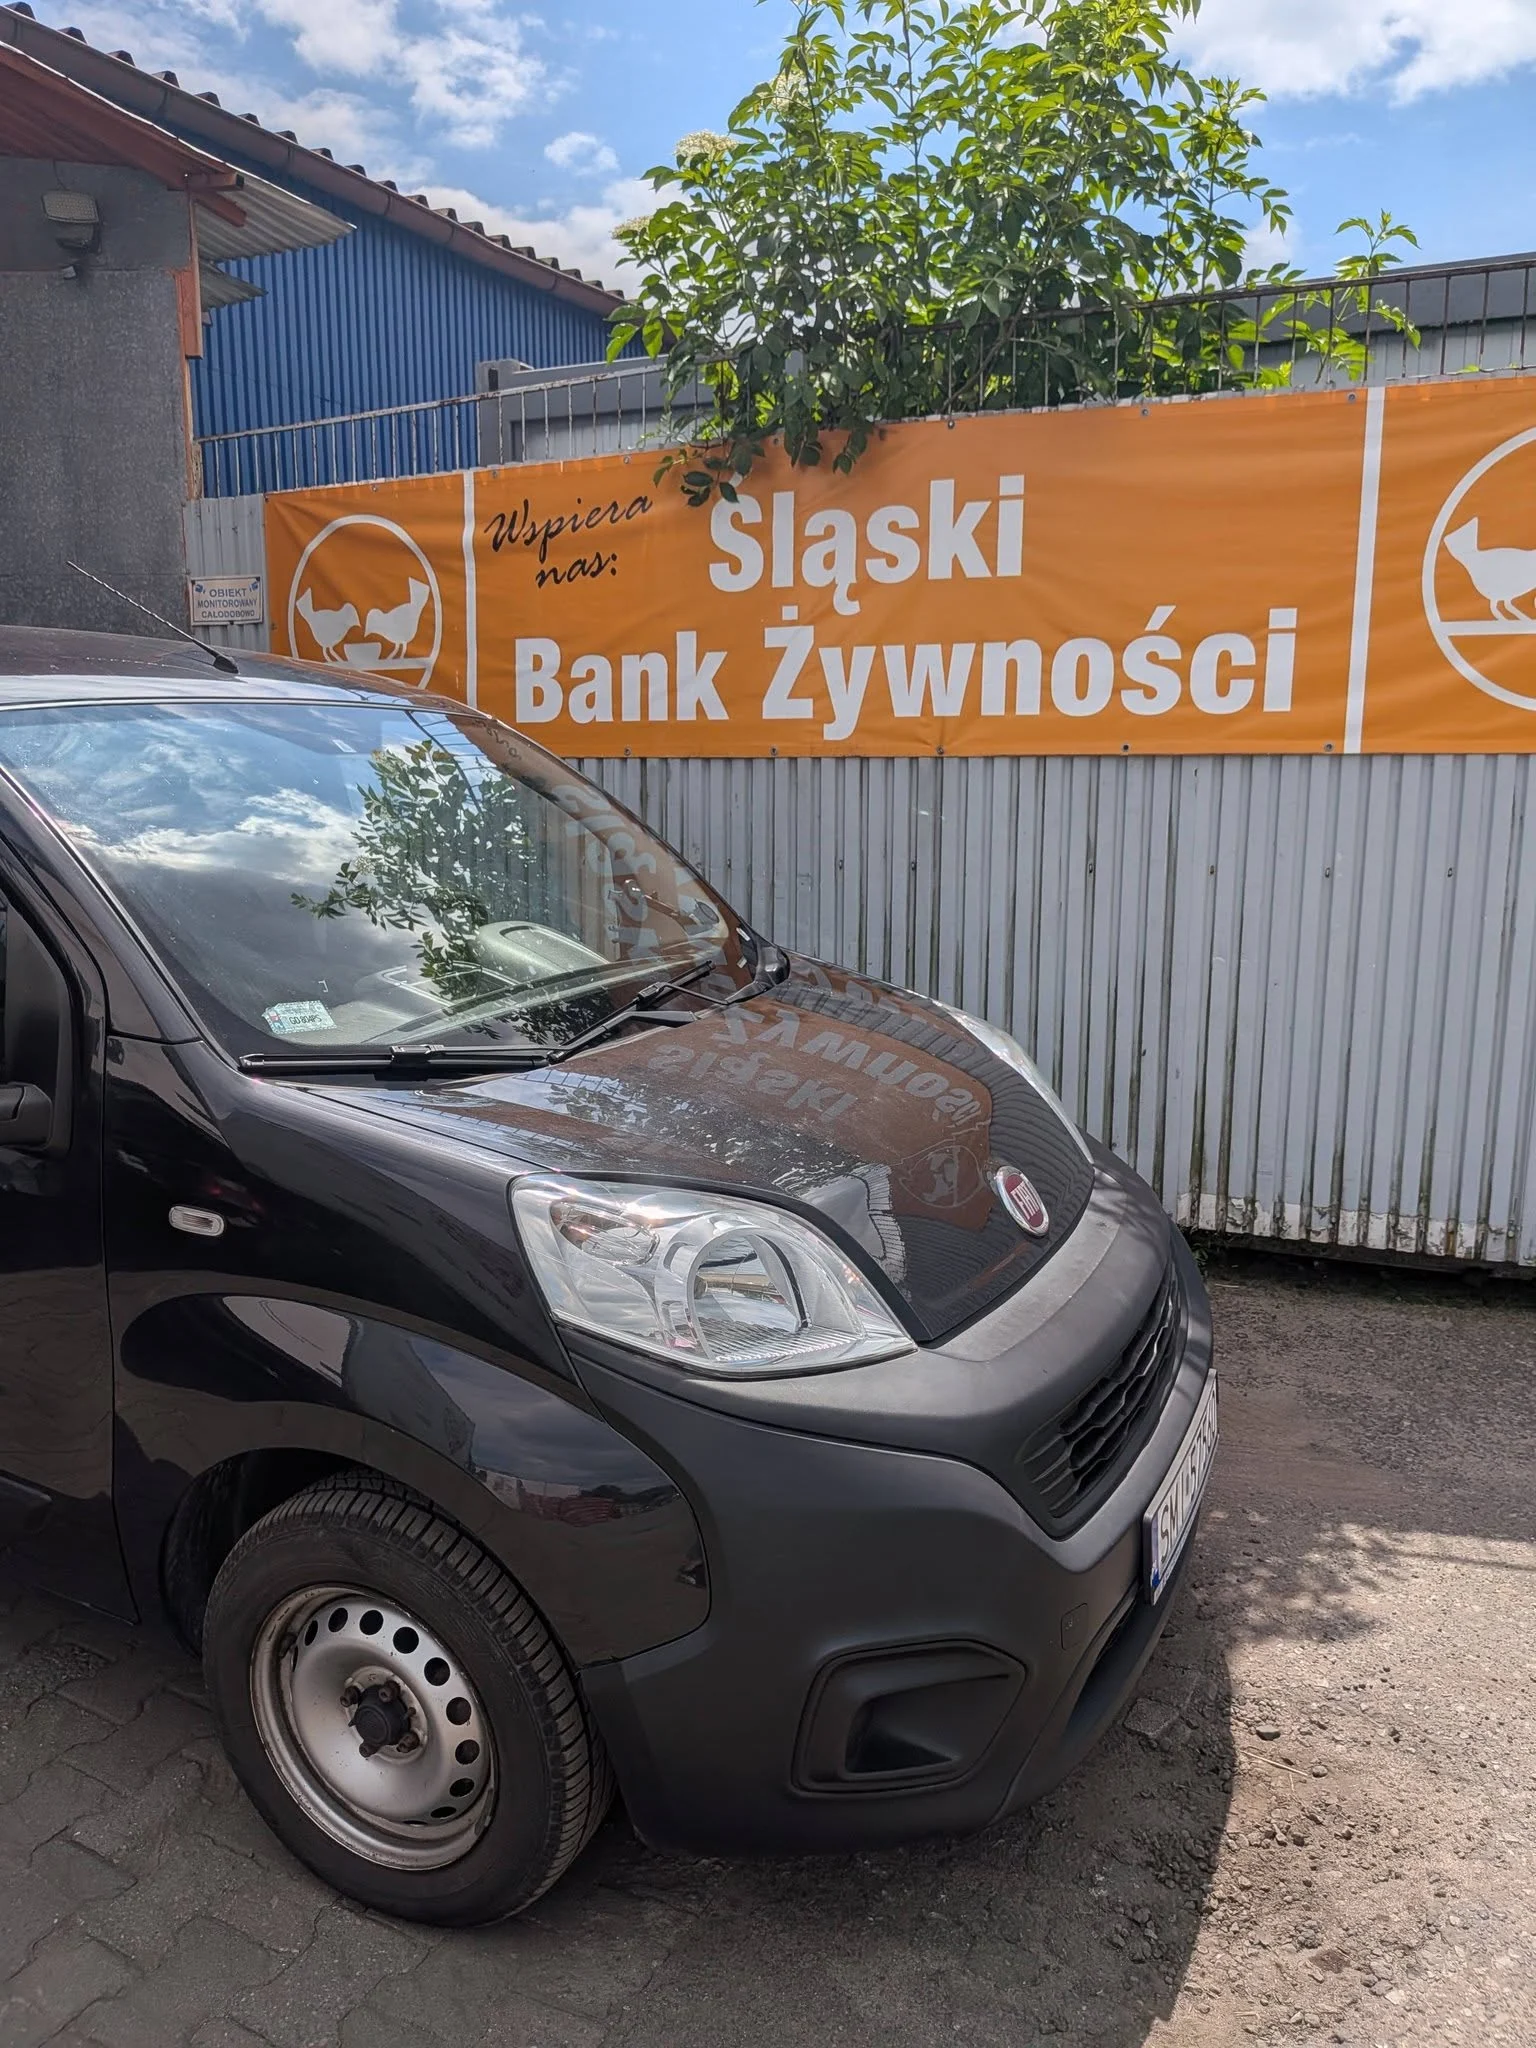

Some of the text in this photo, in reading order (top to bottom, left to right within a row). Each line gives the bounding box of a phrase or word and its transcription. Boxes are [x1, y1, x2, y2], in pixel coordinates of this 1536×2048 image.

[484, 495, 654, 564] Wspiera
[709, 472, 1025, 616] Śląski
[209, 588, 247, 598] OBIEKT
[535, 551, 618, 589] nas:
[197, 599, 258, 609] MONITOROWANY
[515, 605, 1297, 741] Bank Żywności
[1009, 1180, 1040, 1221] FIAT
[1160, 1470, 1184, 1565] SMI
